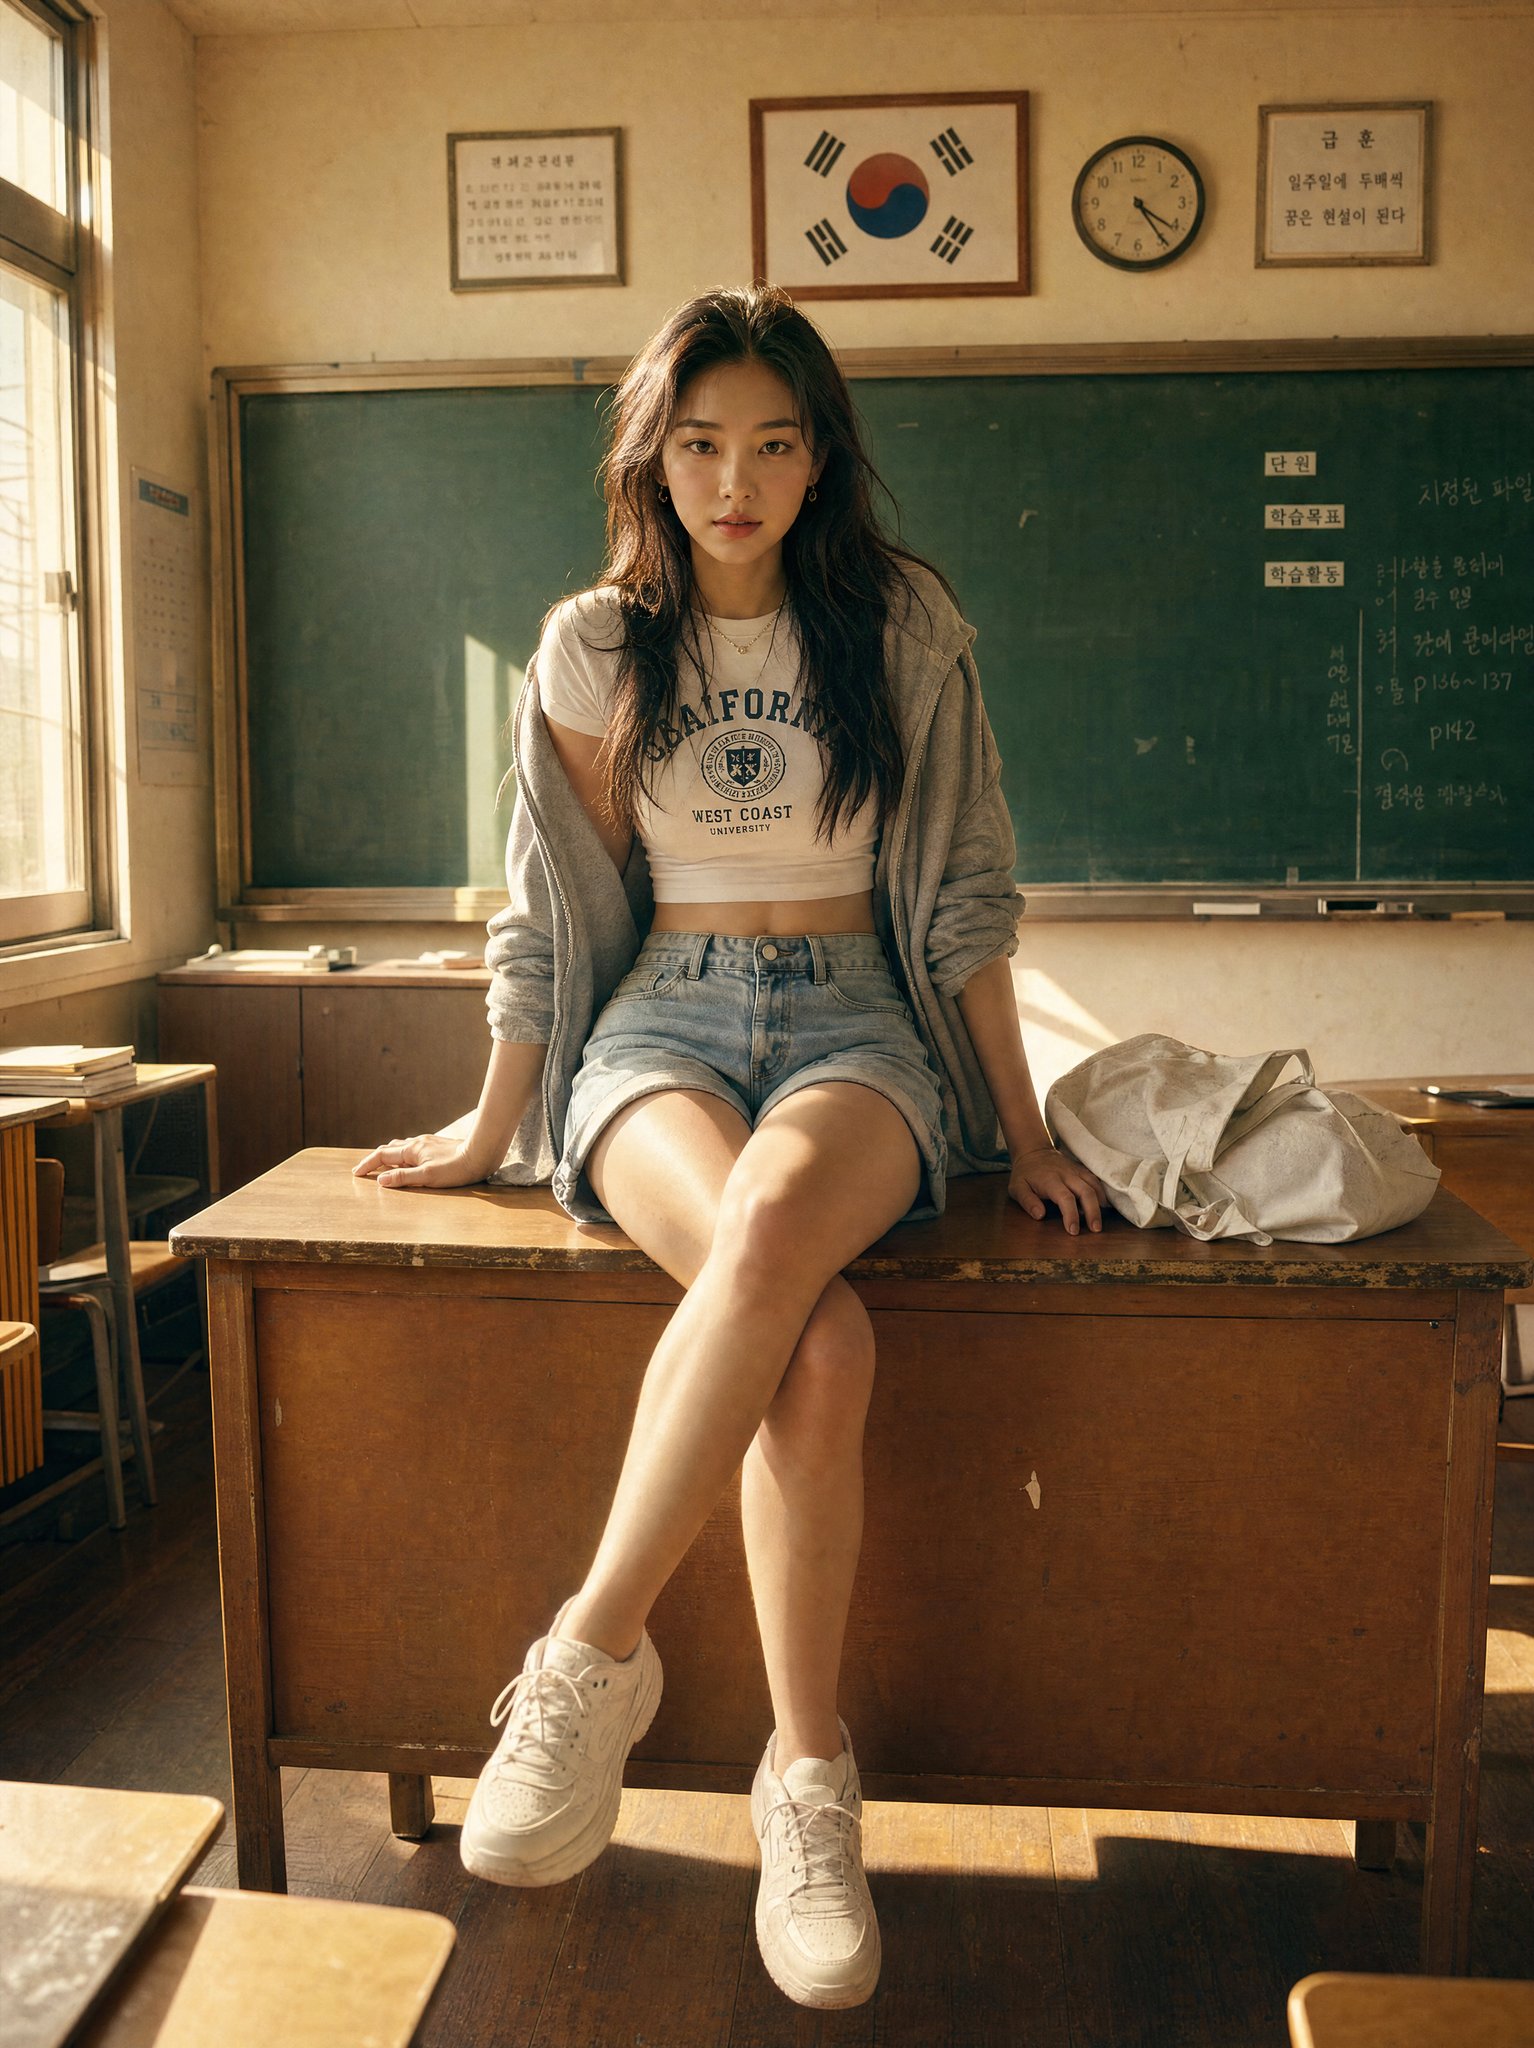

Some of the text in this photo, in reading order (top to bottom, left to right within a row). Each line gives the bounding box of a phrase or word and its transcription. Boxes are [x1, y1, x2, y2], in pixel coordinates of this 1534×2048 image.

[1113, 161, 1123, 173] 11
[1132, 155, 1145, 168] 12
[1097, 176, 1109, 189] 10
[1170, 174, 1179, 188] 2
[1288, 172, 1347, 191] 일주일에
[1091, 197, 1099, 209] 9
[1178, 196, 1186, 209] 3
[1284, 209, 1313, 227] 꿈은
[1376, 206, 1405, 225] 된다
[1097, 218, 1106, 231] 8
[1114, 233, 1122, 246] 7
[1134, 238, 1142, 251] 6
[1270, 508, 1341, 526] 학습목표
[1270, 565, 1341, 584] 학습활동
[1429, 720, 1478, 751] p142
[692, 805, 793, 824] WEST COAST
[709, 823, 771, 836] UNIVERSITY
